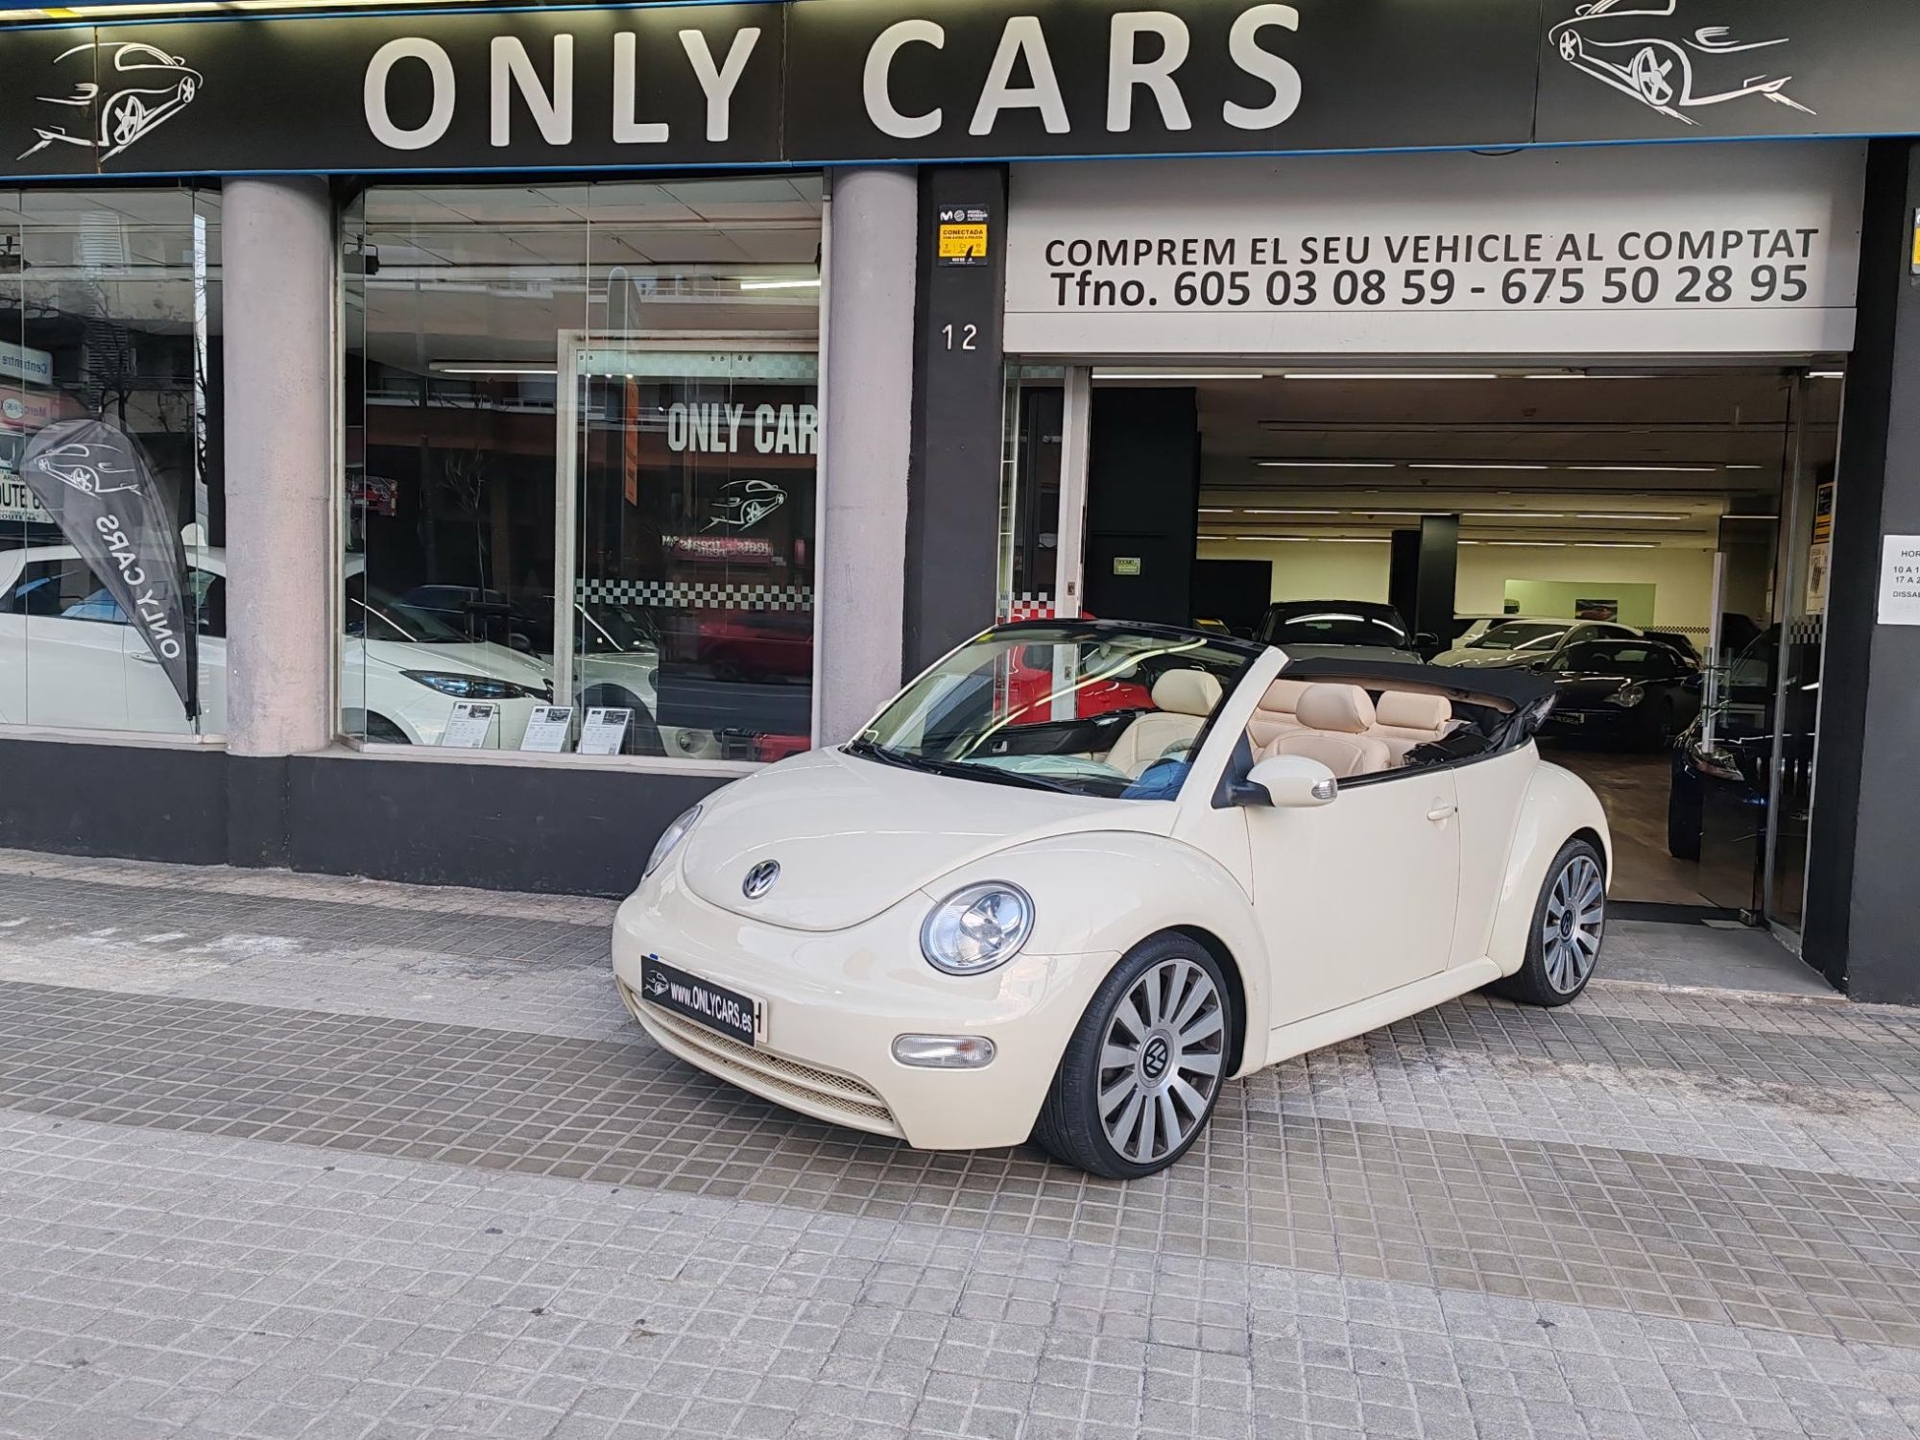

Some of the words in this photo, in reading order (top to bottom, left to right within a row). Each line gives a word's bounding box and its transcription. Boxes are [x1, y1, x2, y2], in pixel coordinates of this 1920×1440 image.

[363, 28, 760, 150] ONLY
[862, 4, 1301, 140] CARS
[1045, 237, 1235, 266] COMPREM
[1251, 237, 1288, 265] EL
[1300, 236, 1370, 264] SEU
[1385, 234, 1542, 263] VEHICLE
[1556, 232, 1603, 261] AL
[1618, 229, 1819, 260] COMPTAT
[1050, 270, 1157, 306] Tfno.
[1174, 271, 1251, 305] 605
[1266, 270, 1317, 305] 03
[1333, 269, 1386, 305] 08
[1401, 268, 1455, 304] 59
[1502, 268, 1585, 304] 675
[1602, 266, 1659, 303] 50
[1675, 265, 1733, 302] 28
[1750, 264, 1808, 302] 95
[941, 323, 977, 350] 12
[668, 402, 744, 453] ONLY
[754, 404, 818, 454] CAR
[671, 982, 752, 1033] www.ONLYCARS.es
